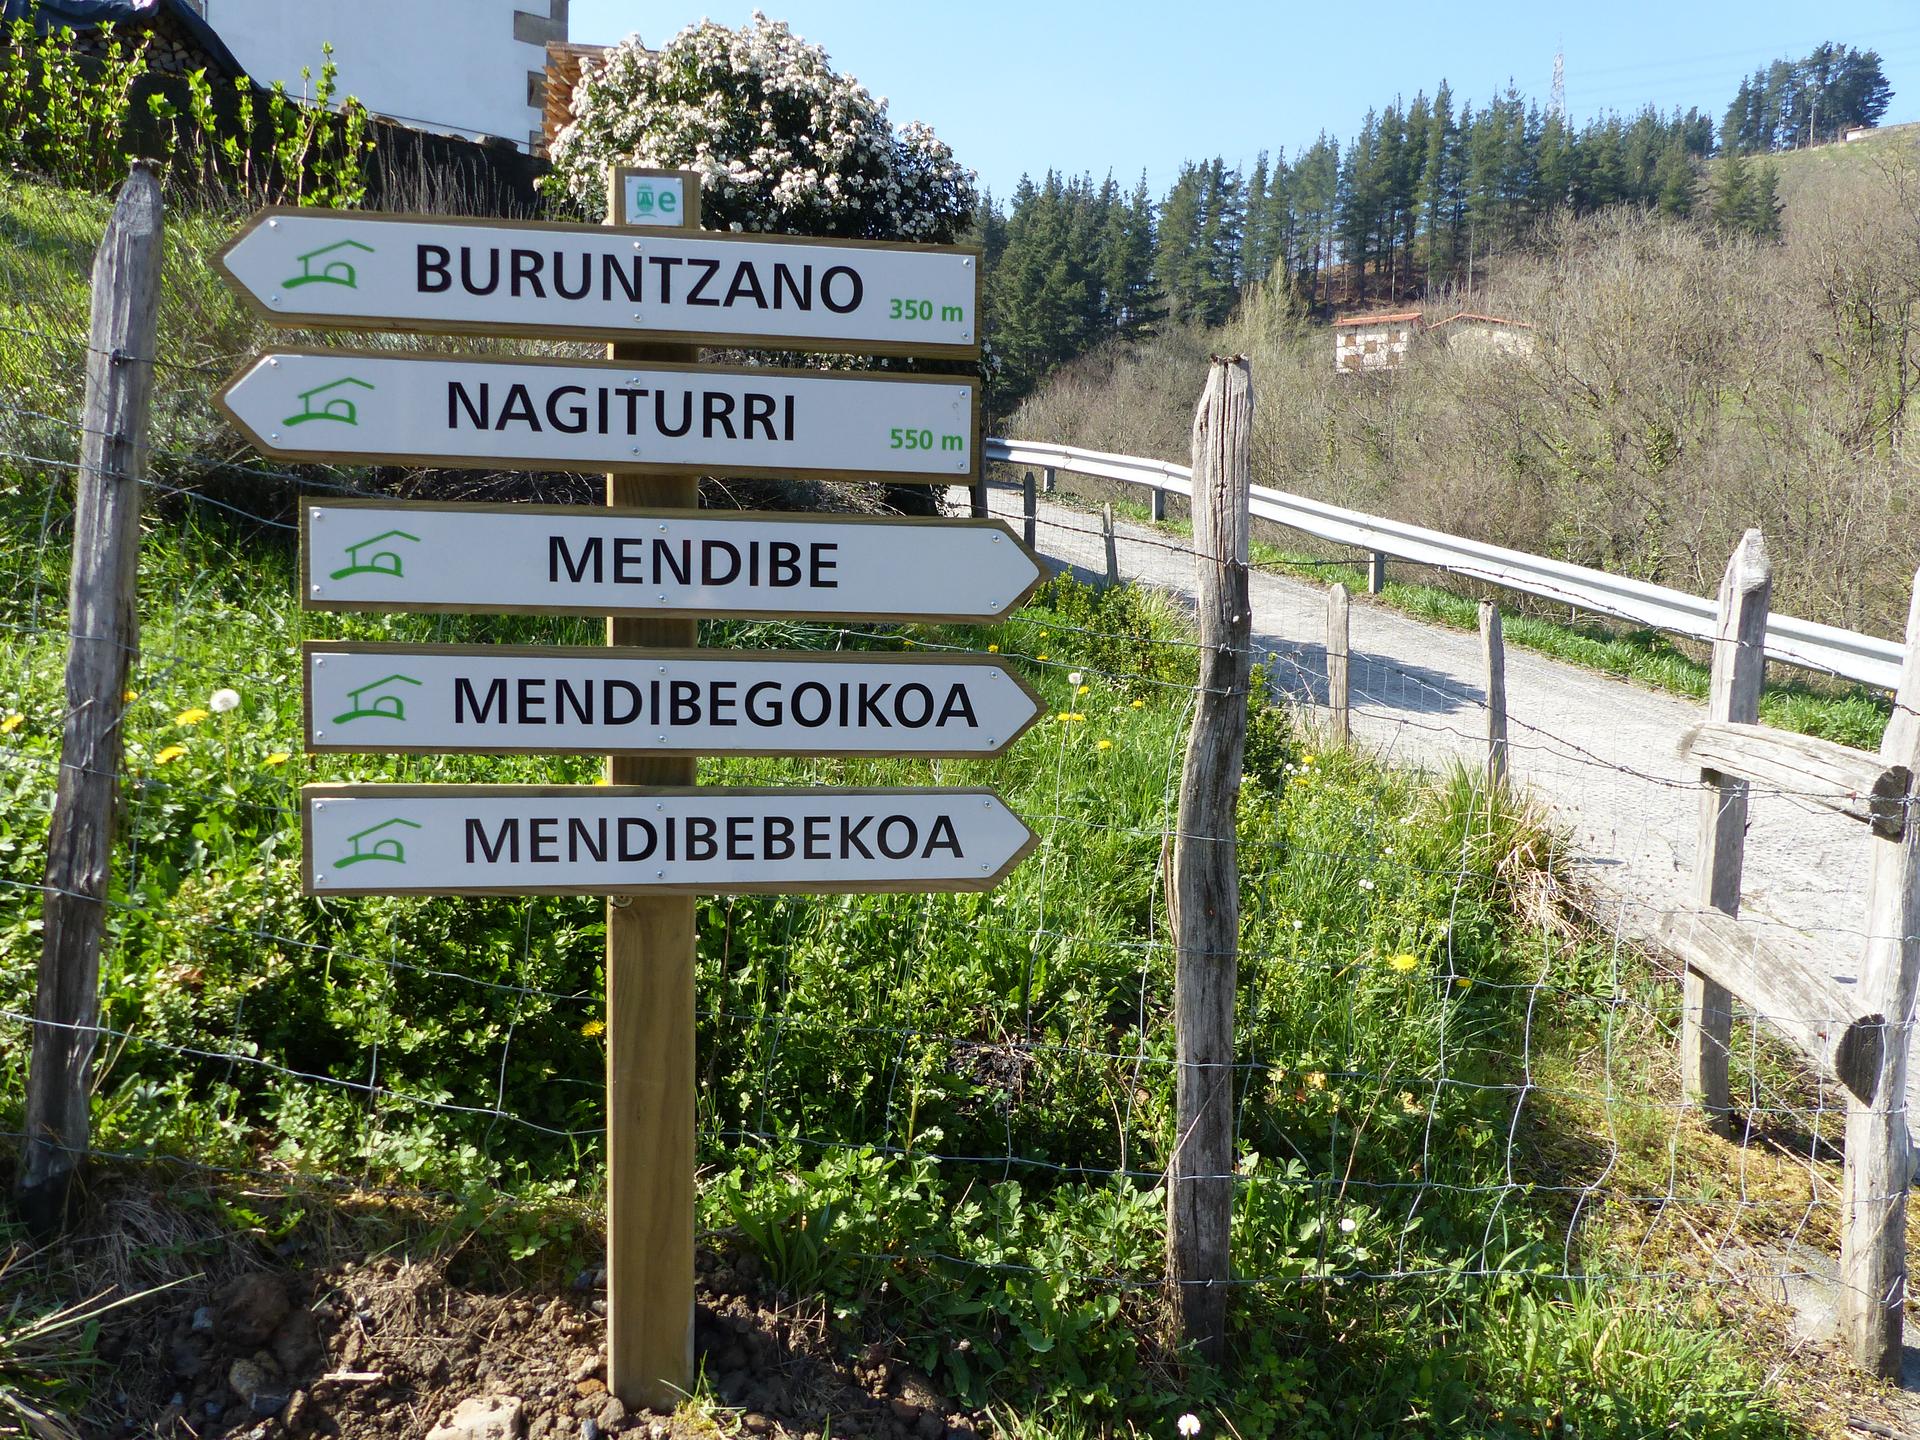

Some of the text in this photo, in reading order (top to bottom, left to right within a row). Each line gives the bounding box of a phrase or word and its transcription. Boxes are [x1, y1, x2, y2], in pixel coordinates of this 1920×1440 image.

[416, 244, 864, 314] BURUNTZANO
[889, 298, 963, 322] 350 m
[447, 381, 795, 442] NAGITURRI
[890, 428, 963, 451] 550 m
[549, 535, 839, 589] MENDIBE
[454, 677, 979, 728] MENDIBEGOIKOA
[465, 814, 965, 864] MENDIBEBEKOA
